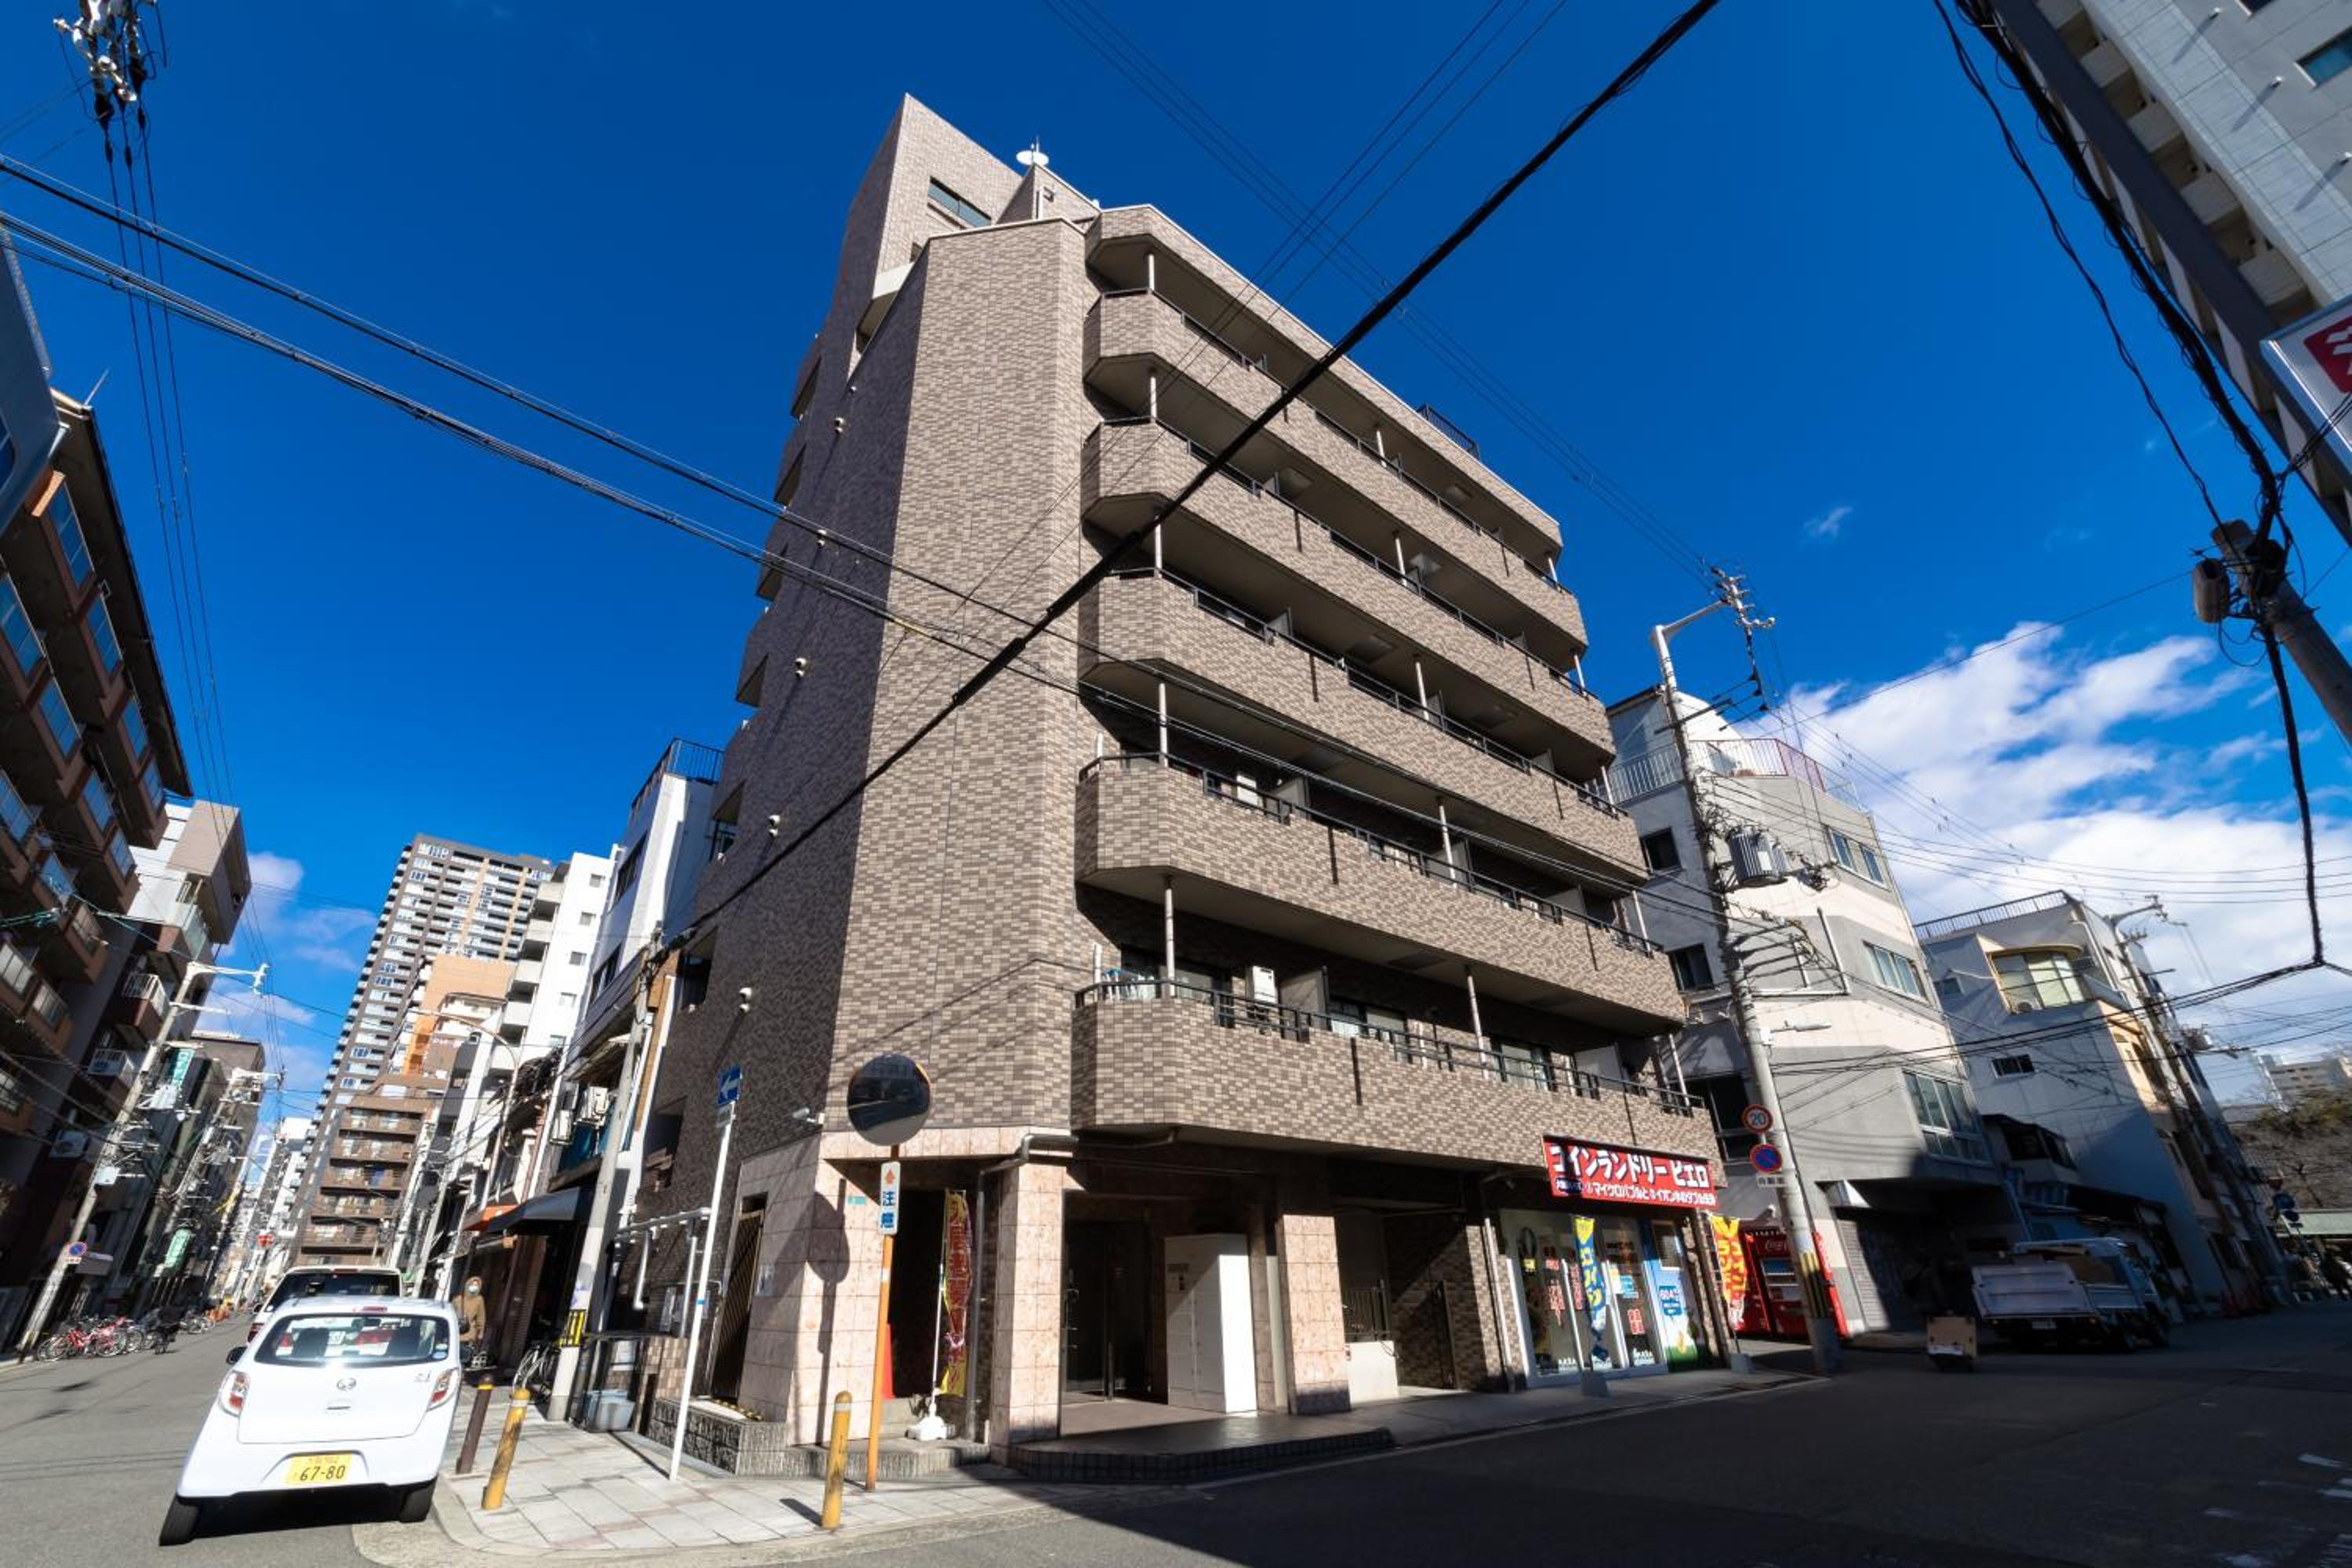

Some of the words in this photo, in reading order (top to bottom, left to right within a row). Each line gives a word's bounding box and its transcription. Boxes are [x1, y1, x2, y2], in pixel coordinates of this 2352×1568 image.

[1749, 1112, 1766, 1126] 20
[1550, 1145, 1668, 1185] コインランドリー
[880, 1191, 896, 1229] 注意
[300, 1465, 346, 1481] 67-80
